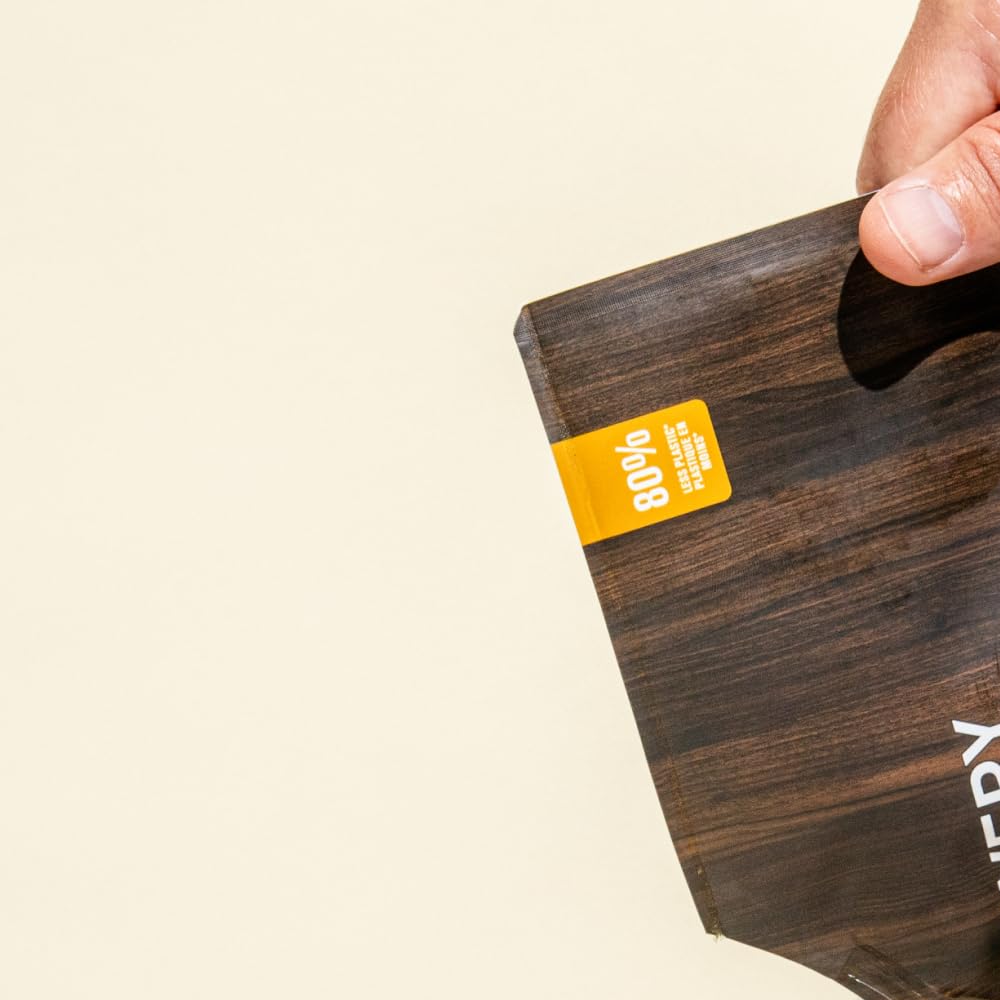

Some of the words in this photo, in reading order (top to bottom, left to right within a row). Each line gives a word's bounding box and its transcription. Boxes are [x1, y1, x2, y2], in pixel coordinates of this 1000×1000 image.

[676, 421, 688, 435] EN
[615, 429, 668, 511] 80%
[677, 469, 692, 493] LESS
[681, 437, 703, 489] PLASTIQUE
